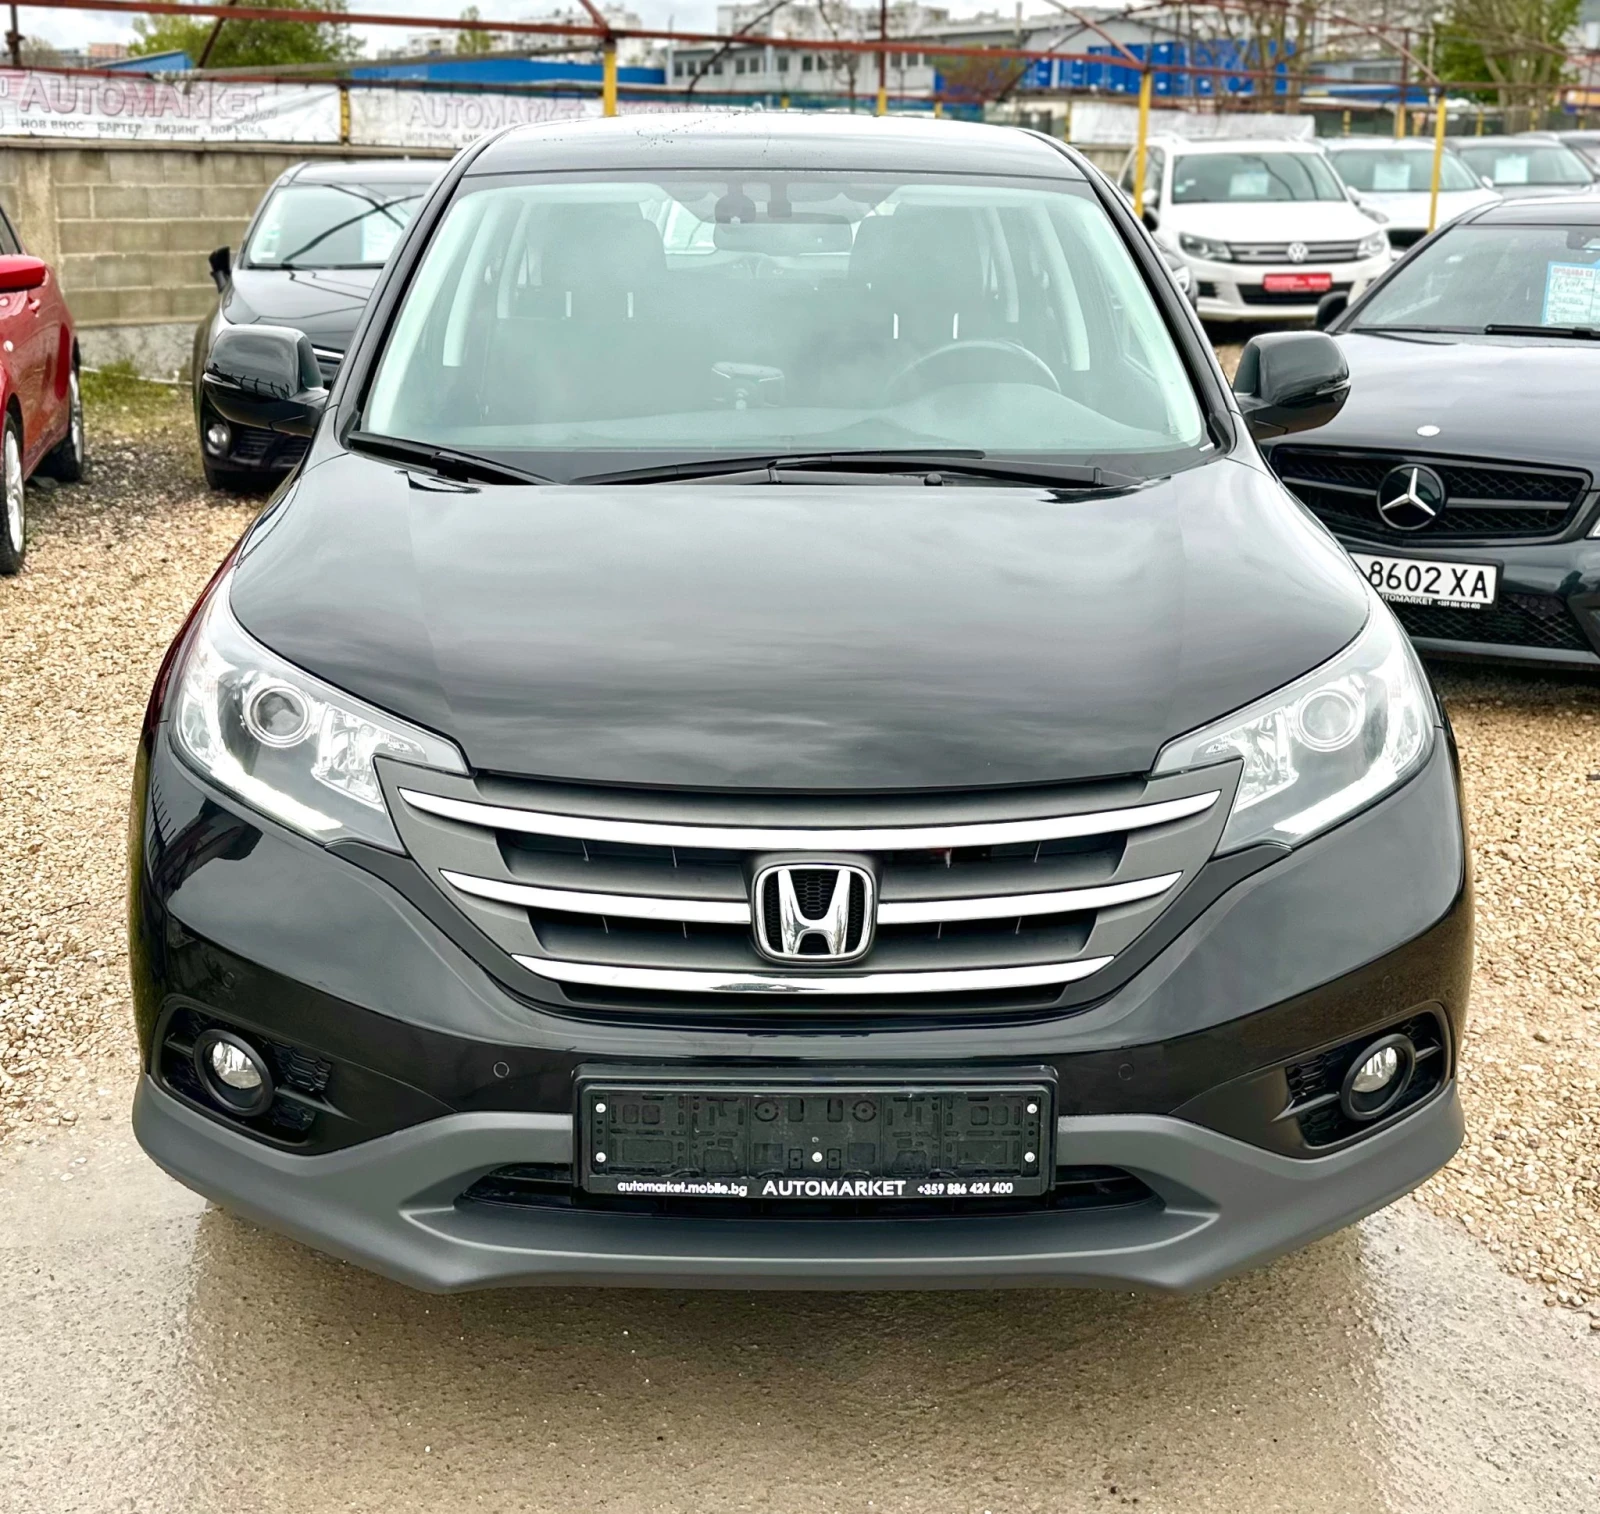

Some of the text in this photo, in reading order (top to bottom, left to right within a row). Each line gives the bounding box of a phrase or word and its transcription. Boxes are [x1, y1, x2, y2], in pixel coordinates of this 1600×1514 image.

[20, 77, 265, 119] AUTOMARKET
[21, 119, 47, 130] НОВ
[51, 120, 85, 132] ВНОС
[1369, 561, 1442, 594] 8602
[617, 1180, 1014, 1197] automarket.mobile.bg AUTOMARKET +359 886 424 400
